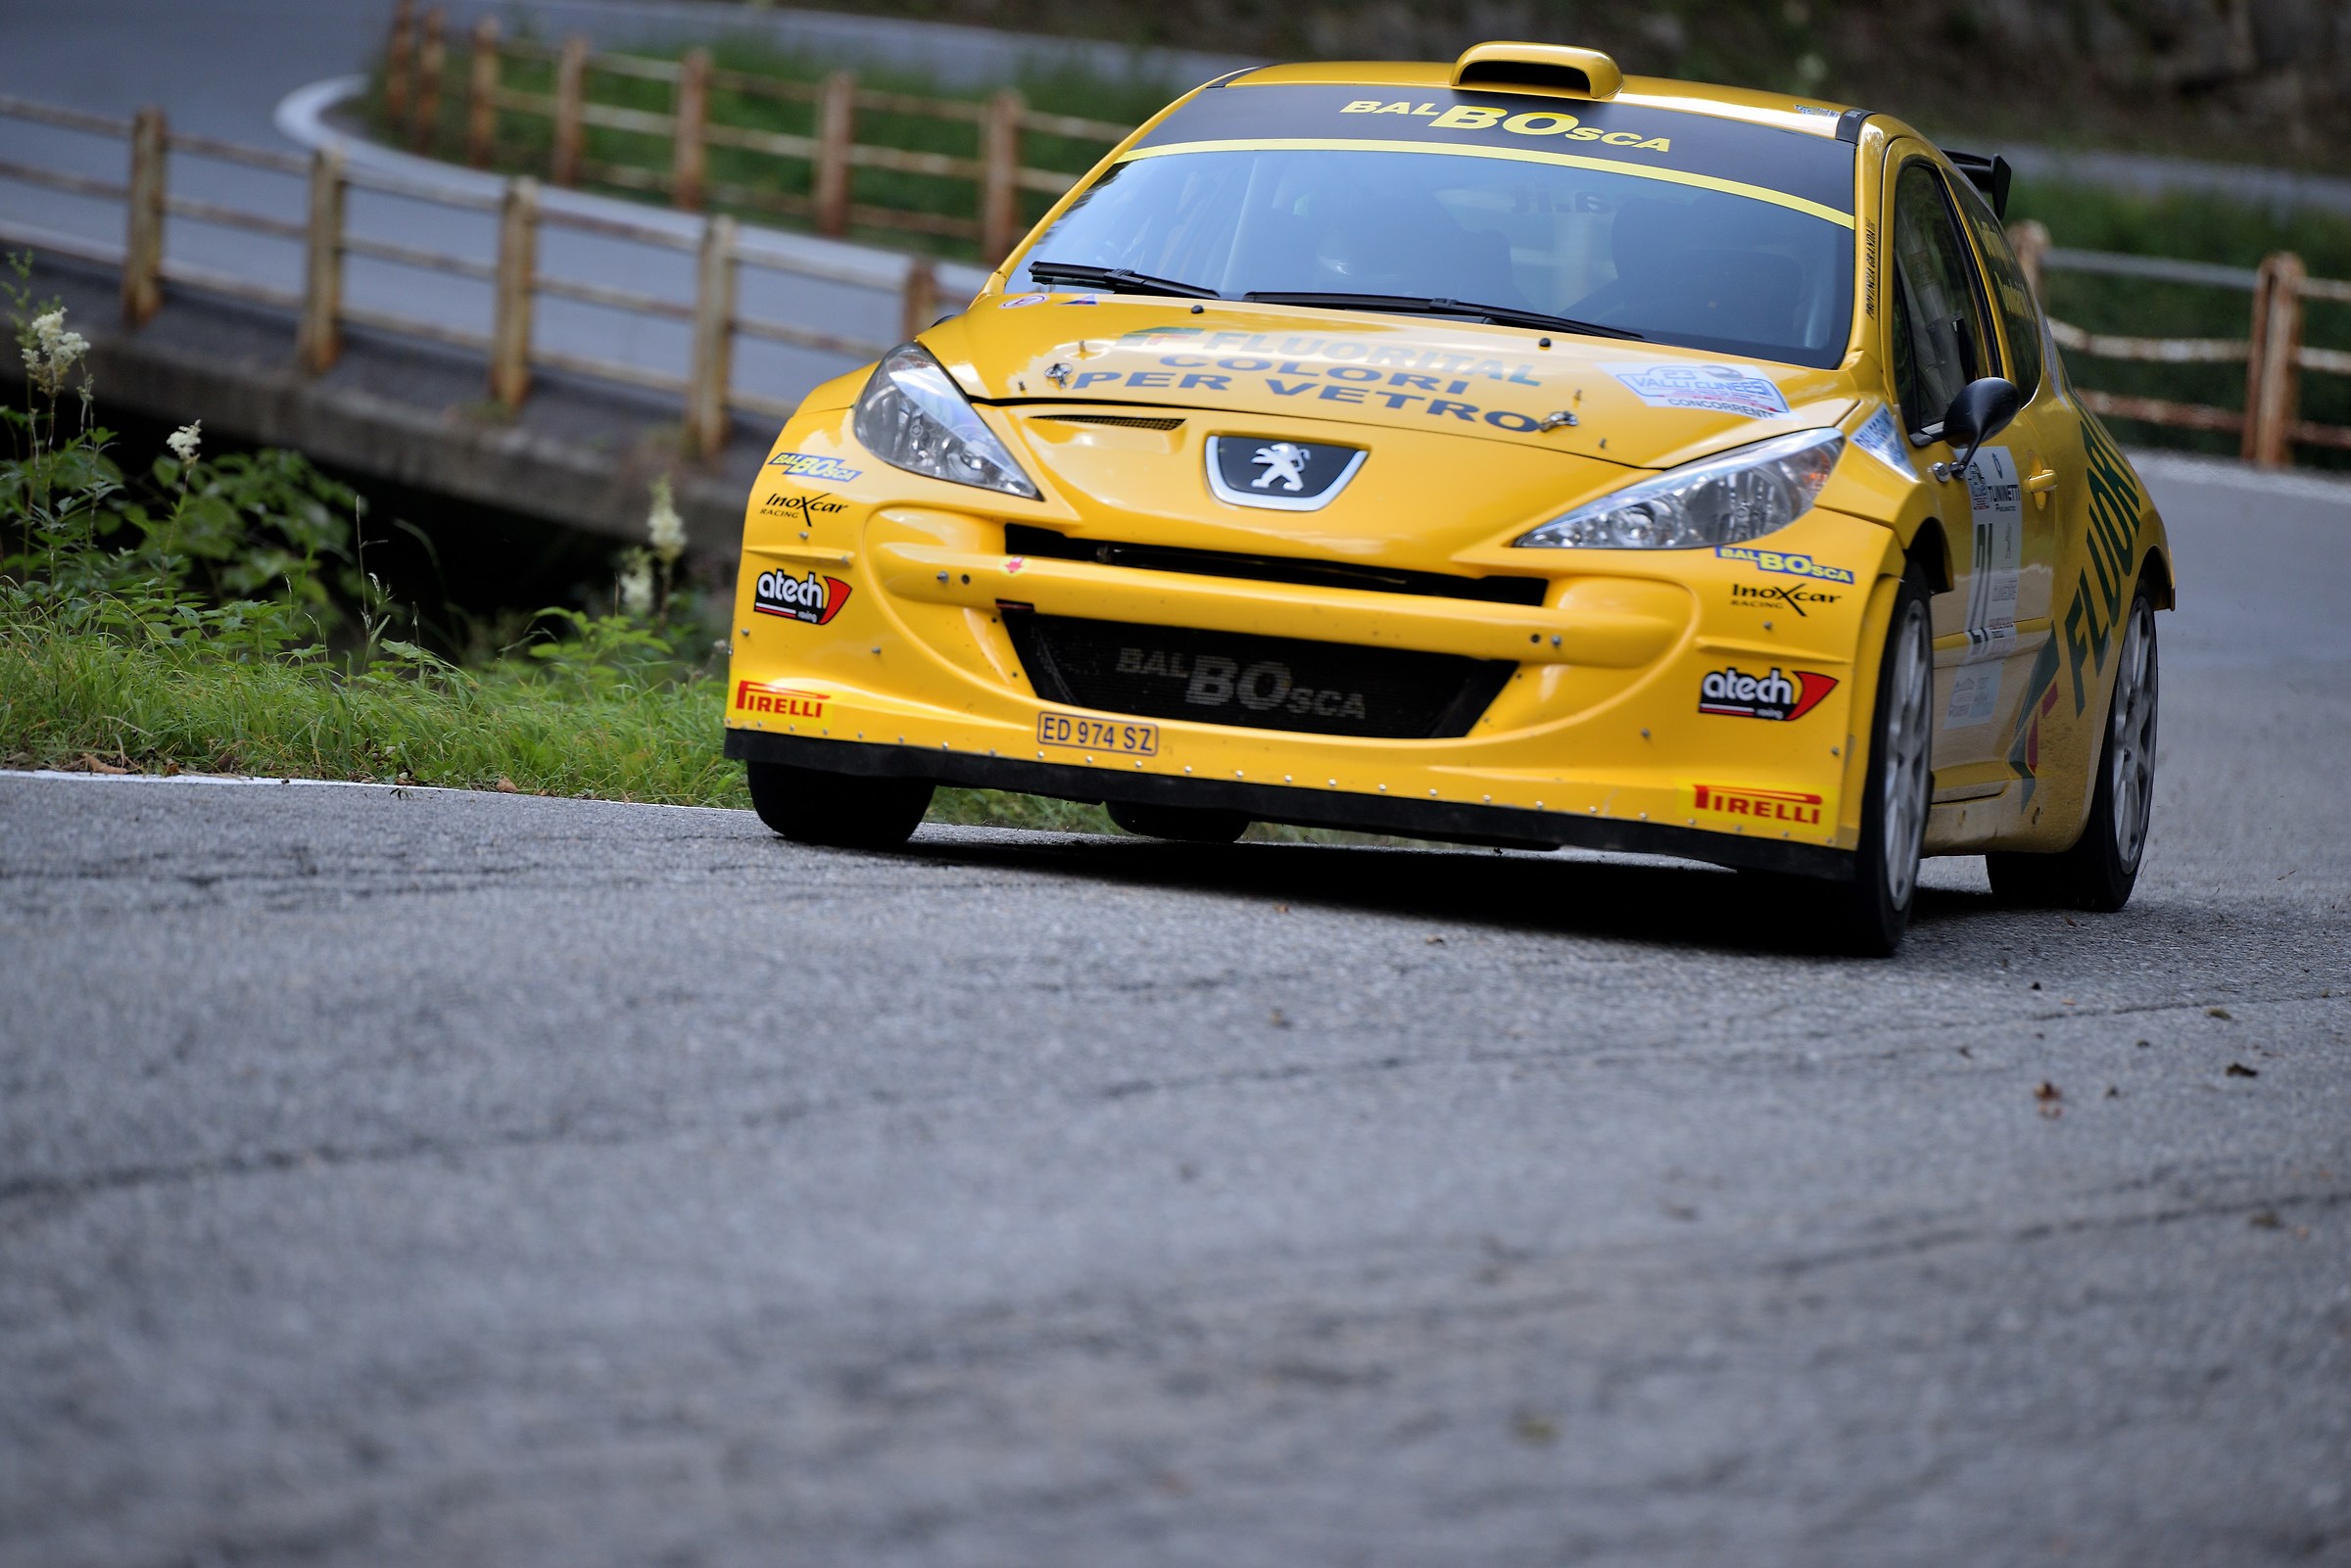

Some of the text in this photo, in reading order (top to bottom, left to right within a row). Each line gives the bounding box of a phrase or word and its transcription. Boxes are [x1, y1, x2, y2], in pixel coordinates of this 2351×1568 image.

[1339, 100, 1671, 153] BALBOSCA
[1159, 354, 1469, 396] COLORI
[1201, 330, 1542, 388] FLUORITAL
[1660, 369, 1698, 380] 23
[1631, 375, 1690, 388] VALLI
[1072, 370, 1541, 433] PER VETRO
[772, 453, 861, 482] BALBOSCA
[760, 508, 799, 519] RACING
[1719, 547, 1853, 582] BALBOSCA
[757, 570, 823, 609] atech
[1731, 599, 1784, 609] RACING
[736, 680, 831, 719] PIRELLI
[1116, 646, 1366, 720] BALBOSCA
[1703, 669, 1793, 705] atech
[1042, 716, 1153, 751] ED 974 SZ
[1694, 784, 1823, 825] PIRELLI
